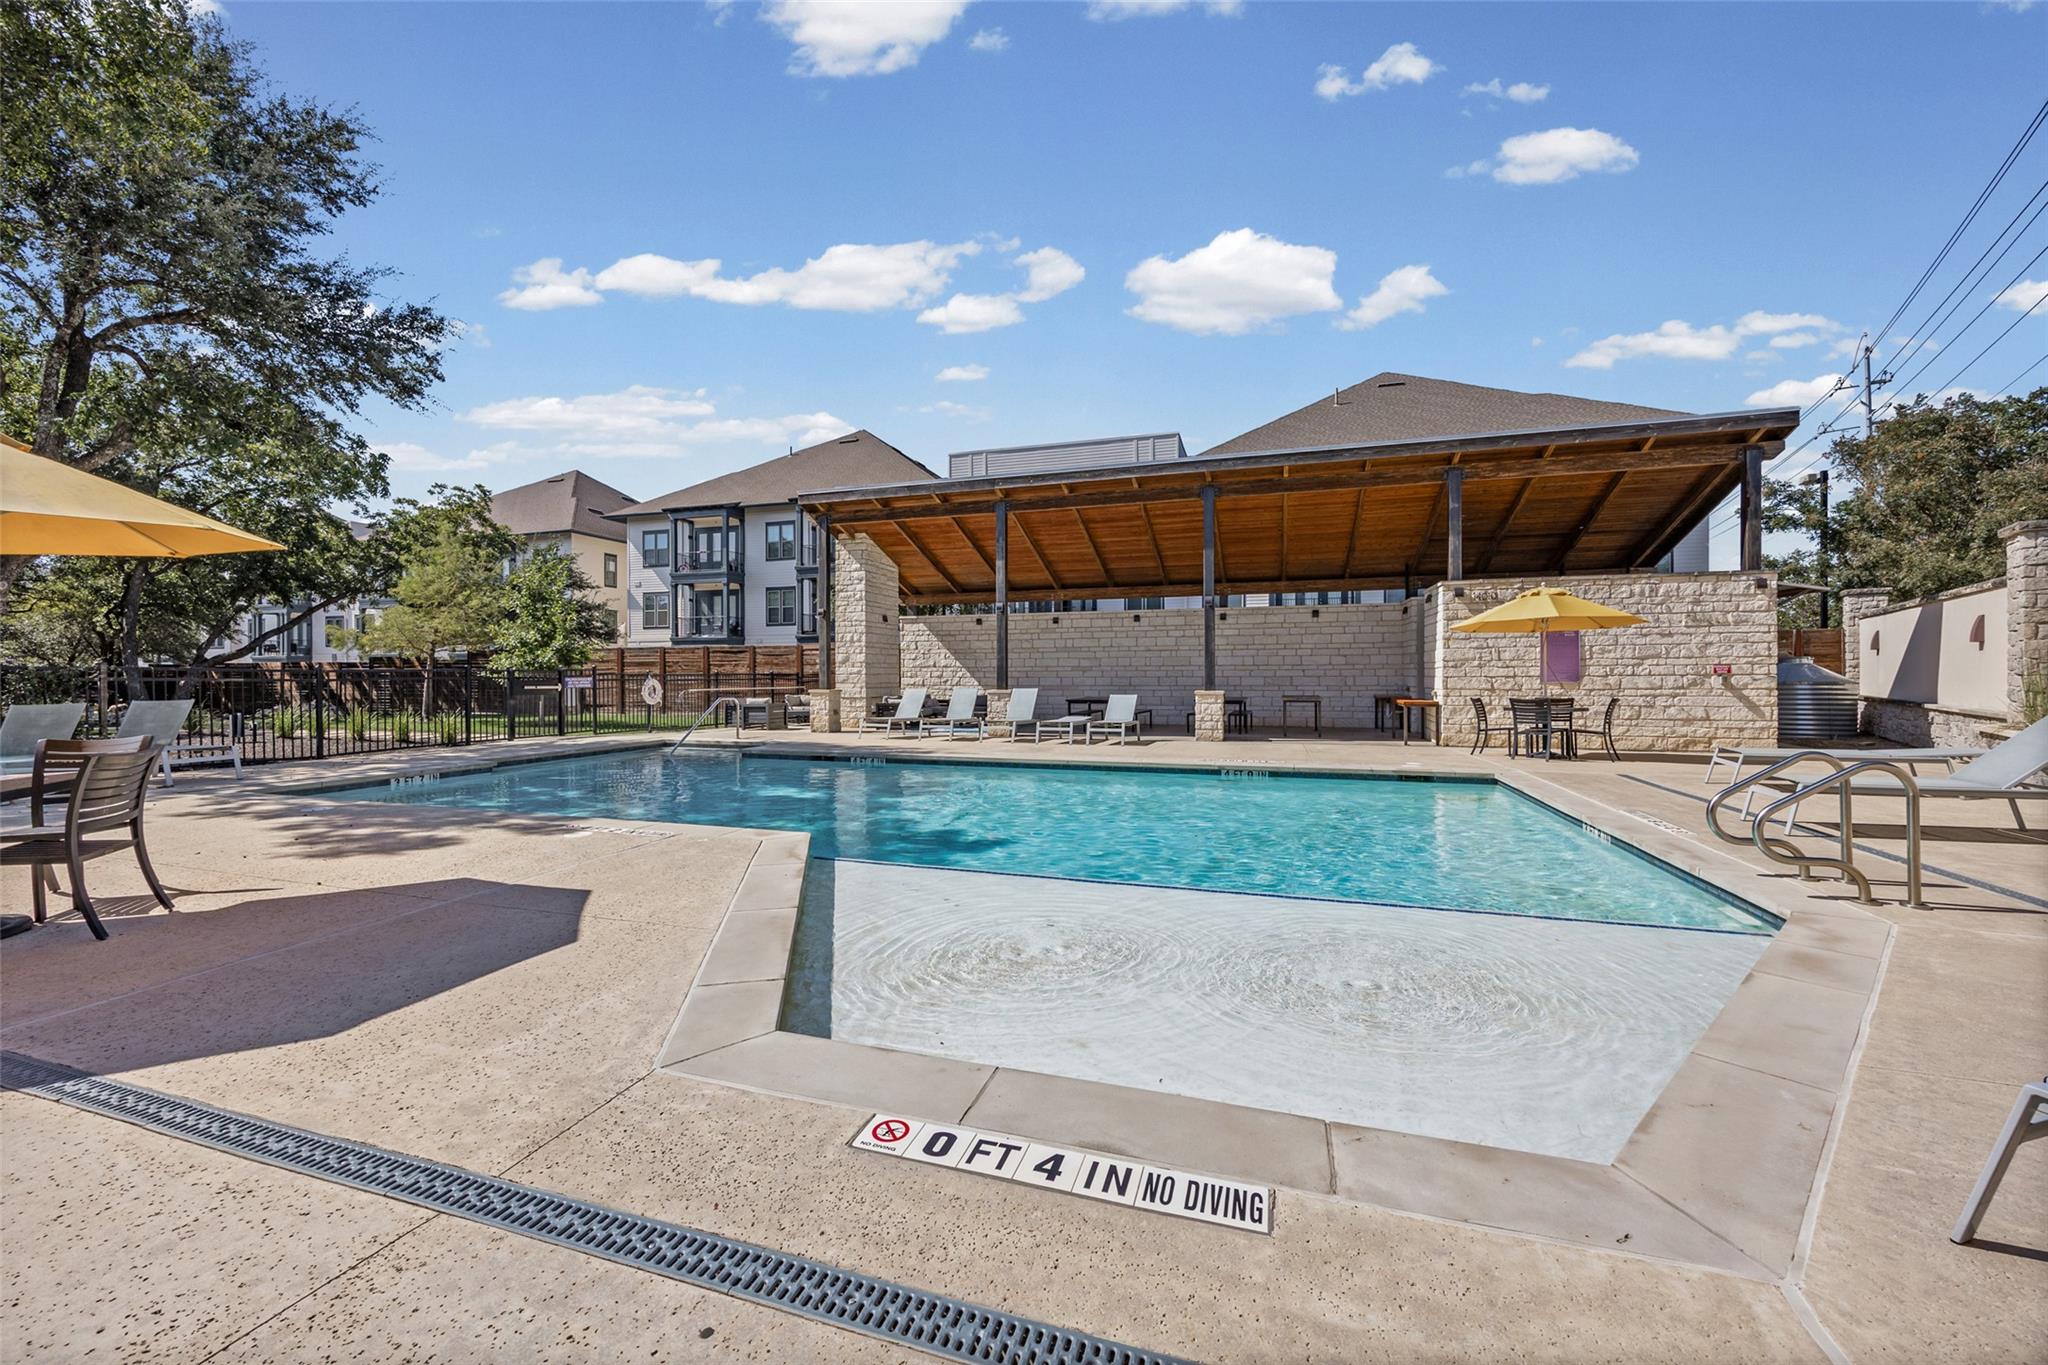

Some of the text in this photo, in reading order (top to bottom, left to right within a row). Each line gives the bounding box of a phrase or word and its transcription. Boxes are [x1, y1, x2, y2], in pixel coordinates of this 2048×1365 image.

[872, 1143, 897, 1152] DIVING
[922, 1131, 1264, 1224] 0 FT 4 IN NO DIVING
